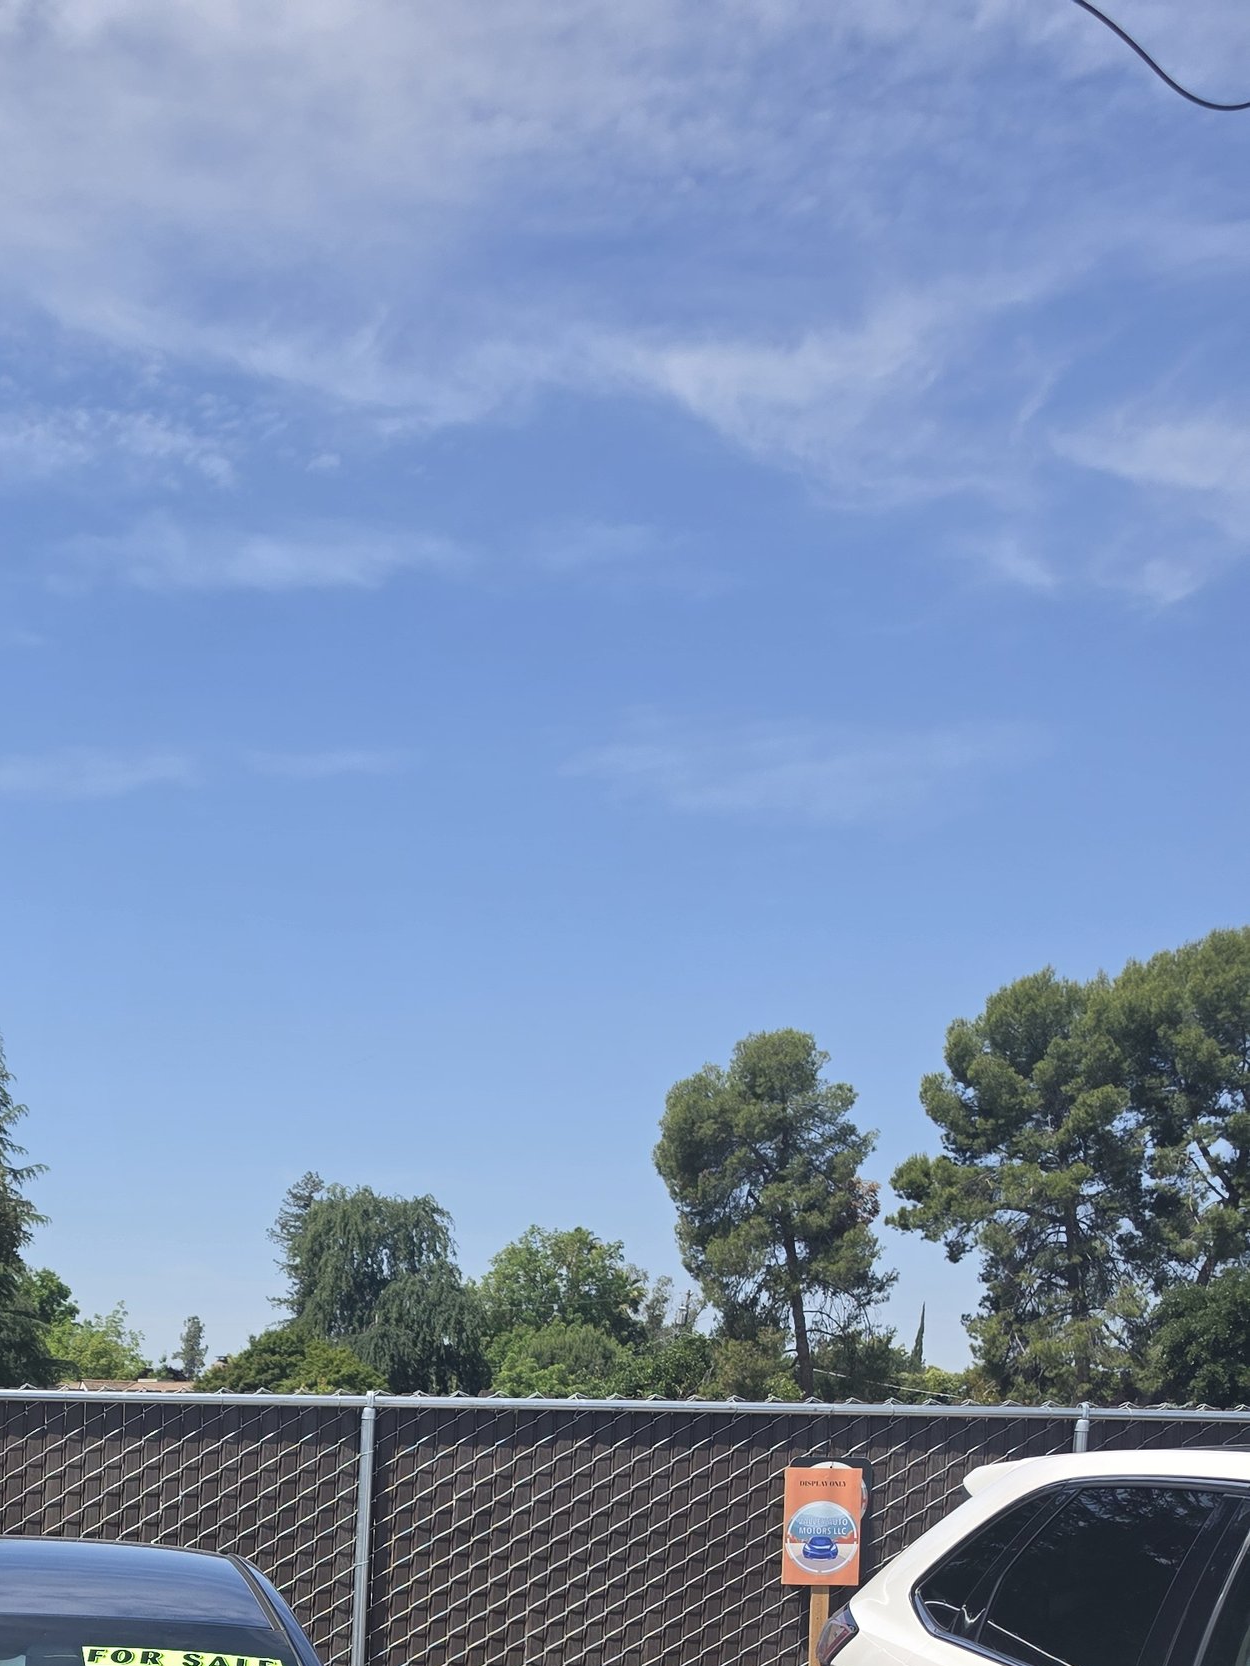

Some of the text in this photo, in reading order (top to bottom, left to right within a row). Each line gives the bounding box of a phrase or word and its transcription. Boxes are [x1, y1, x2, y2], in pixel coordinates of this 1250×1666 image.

[827, 1518, 849, 1526] AUTO
[798, 1526, 847, 1535] MOTORS LLC
[87, 1648, 164, 1666] FOR
